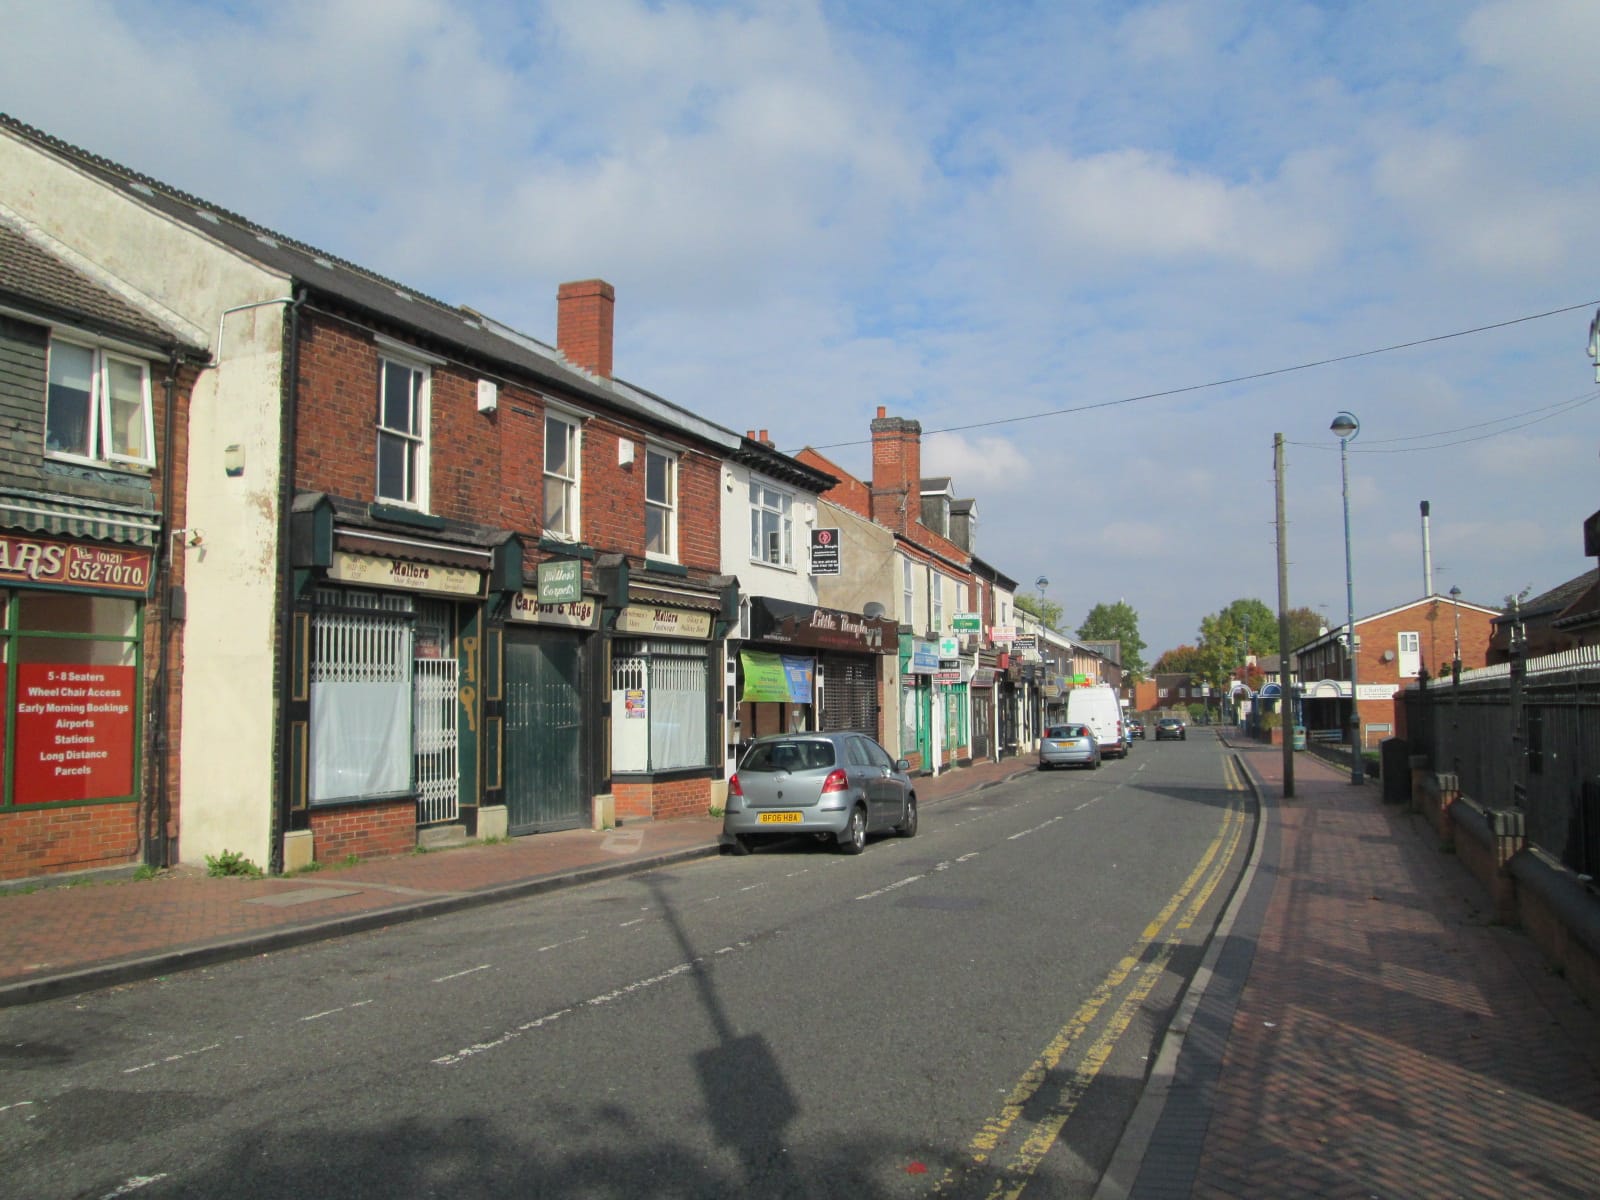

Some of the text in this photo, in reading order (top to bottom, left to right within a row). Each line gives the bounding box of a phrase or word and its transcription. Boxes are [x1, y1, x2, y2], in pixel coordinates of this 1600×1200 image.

[97, 552, 122, 564] (0121)
[389, 560, 430, 579] Mellors
[543, 584, 574, 598] Carpets
[568, 601, 591, 621] Rugs
[653, 608, 678, 623] Mellors
[809, 609, 837, 631] Little
[48, 671, 55, 680] 5
[60, 671, 67, 681] 8
[68, 671, 105, 681] Seaters
[28, 687, 121, 697] Wheel Chair Access
[18, 703, 129, 715] Early Morning Bookings
[55, 719, 95, 730] Airports
[55, 735, 95, 744] Stations
[40, 750, 108, 762] Long Distance
[55, 766, 92, 776] Parcels
